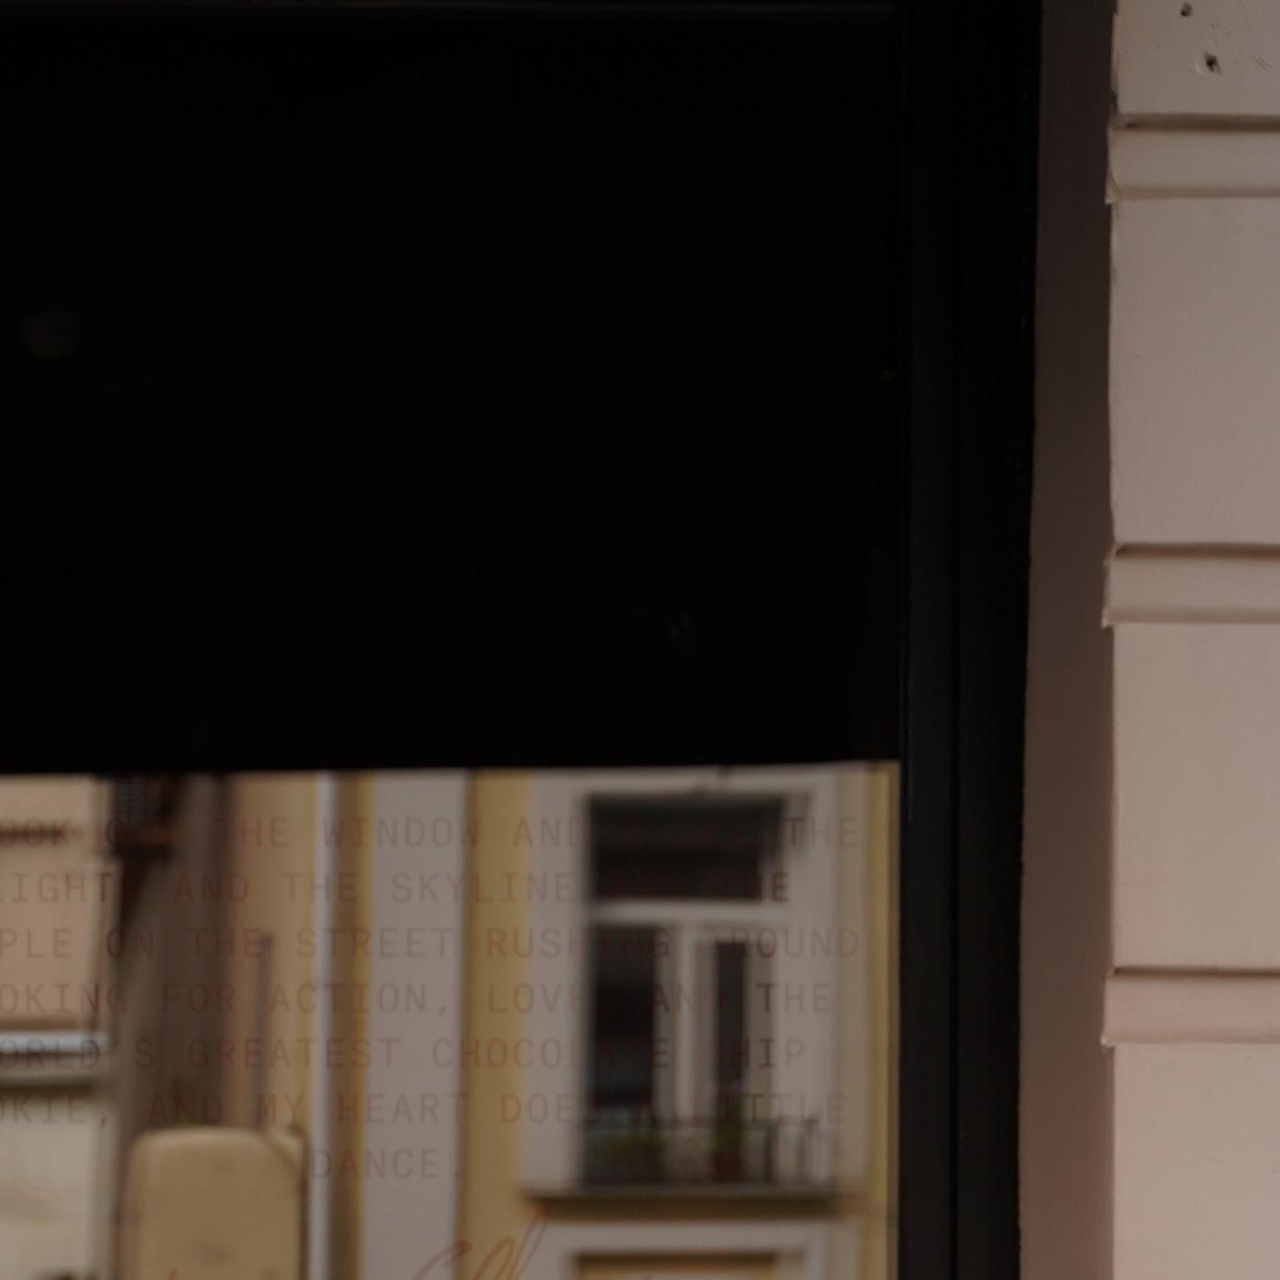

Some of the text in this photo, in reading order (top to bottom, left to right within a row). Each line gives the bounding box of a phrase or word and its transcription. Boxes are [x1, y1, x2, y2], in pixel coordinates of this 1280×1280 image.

[324, 818, 478, 848] WINDOW
[786, 818, 859, 848] THE
[176, 873, 248, 902] AND
[282, 873, 357, 902] THE
[392, 873, 574, 902] SKYLINE
[108, 929, 154, 958] ON
[191, 929, 261, 958] THE
[297, 929, 454, 958] STREET
[702, 929, 860, 958] ROUND
[163, 985, 235, 1014] FOR
[269, 985, 448, 1017] ACTION,
[757, 985, 833, 1013] THE
[190, 1039, 398, 1068] GREATEST
[703, 1039, 805, 1068] HIP
[148, 1094, 222, 1123] AND
[260, 1094, 303, 1123] MY
[337, 1094, 463, 1123] HEART
[689, 1094, 845, 1123] ITTLE
[310, 1149, 463, 1178] DANCE.
